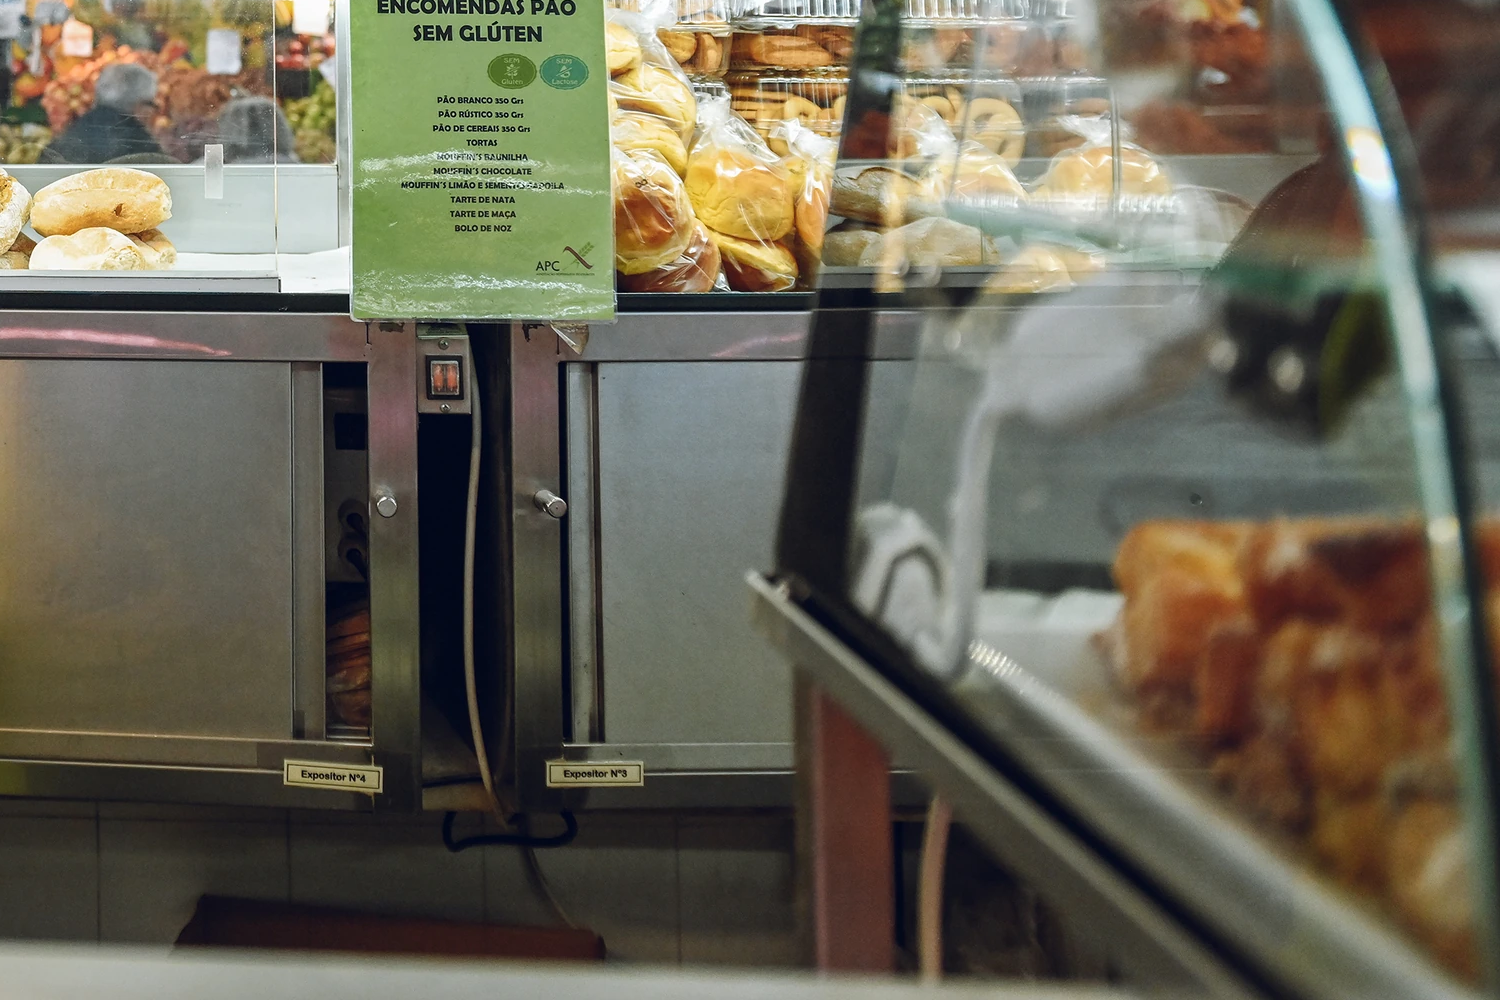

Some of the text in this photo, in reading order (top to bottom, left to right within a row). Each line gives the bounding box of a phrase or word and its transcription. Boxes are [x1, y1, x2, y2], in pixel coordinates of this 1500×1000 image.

[413, 21, 543, 43] SEM GLÚTEN
[551, 78, 578, 86] Lactose
[437, 95, 456, 104] PÃO
[511, 97, 524, 105] Grs
[438, 109, 524, 119] PÃO RÚSTICO 350 Grs
[433, 123, 452, 132] PÃO
[466, 139, 498, 147] TORTAS
[484, 153, 528, 161] BAUNILHA
[449, 180, 476, 189] LIMÃO
[450, 196, 516, 204] TARTE DE NATA
[450, 210, 516, 219] TARTE DE MAÇA
[536, 261, 560, 271] APC
[301, 770, 347, 781] Expositor
[563, 769, 608, 780] Expositor
